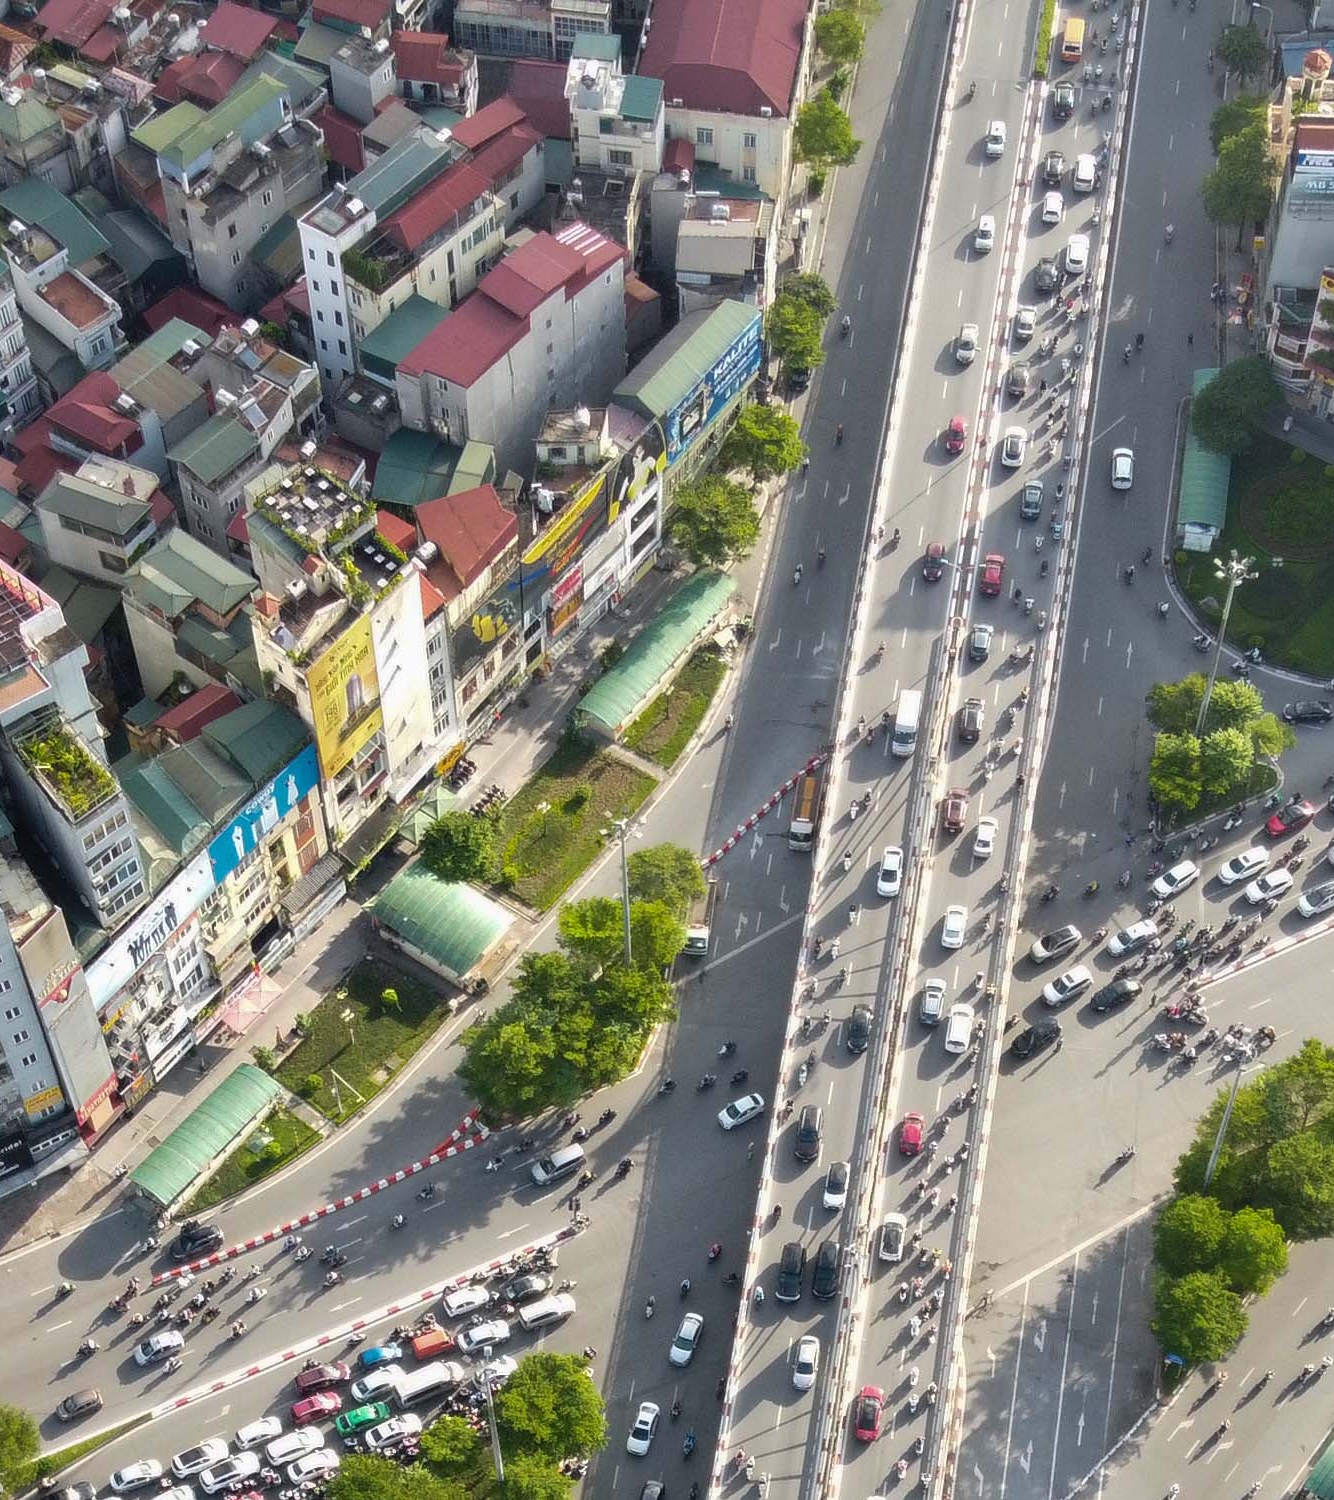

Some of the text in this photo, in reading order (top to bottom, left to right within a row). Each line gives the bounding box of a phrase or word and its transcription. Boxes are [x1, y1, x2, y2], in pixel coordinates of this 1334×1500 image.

[1305, 180, 1326, 190] MB
[713, 324, 758, 379] KALITE
[245, 782, 276, 815] coway
